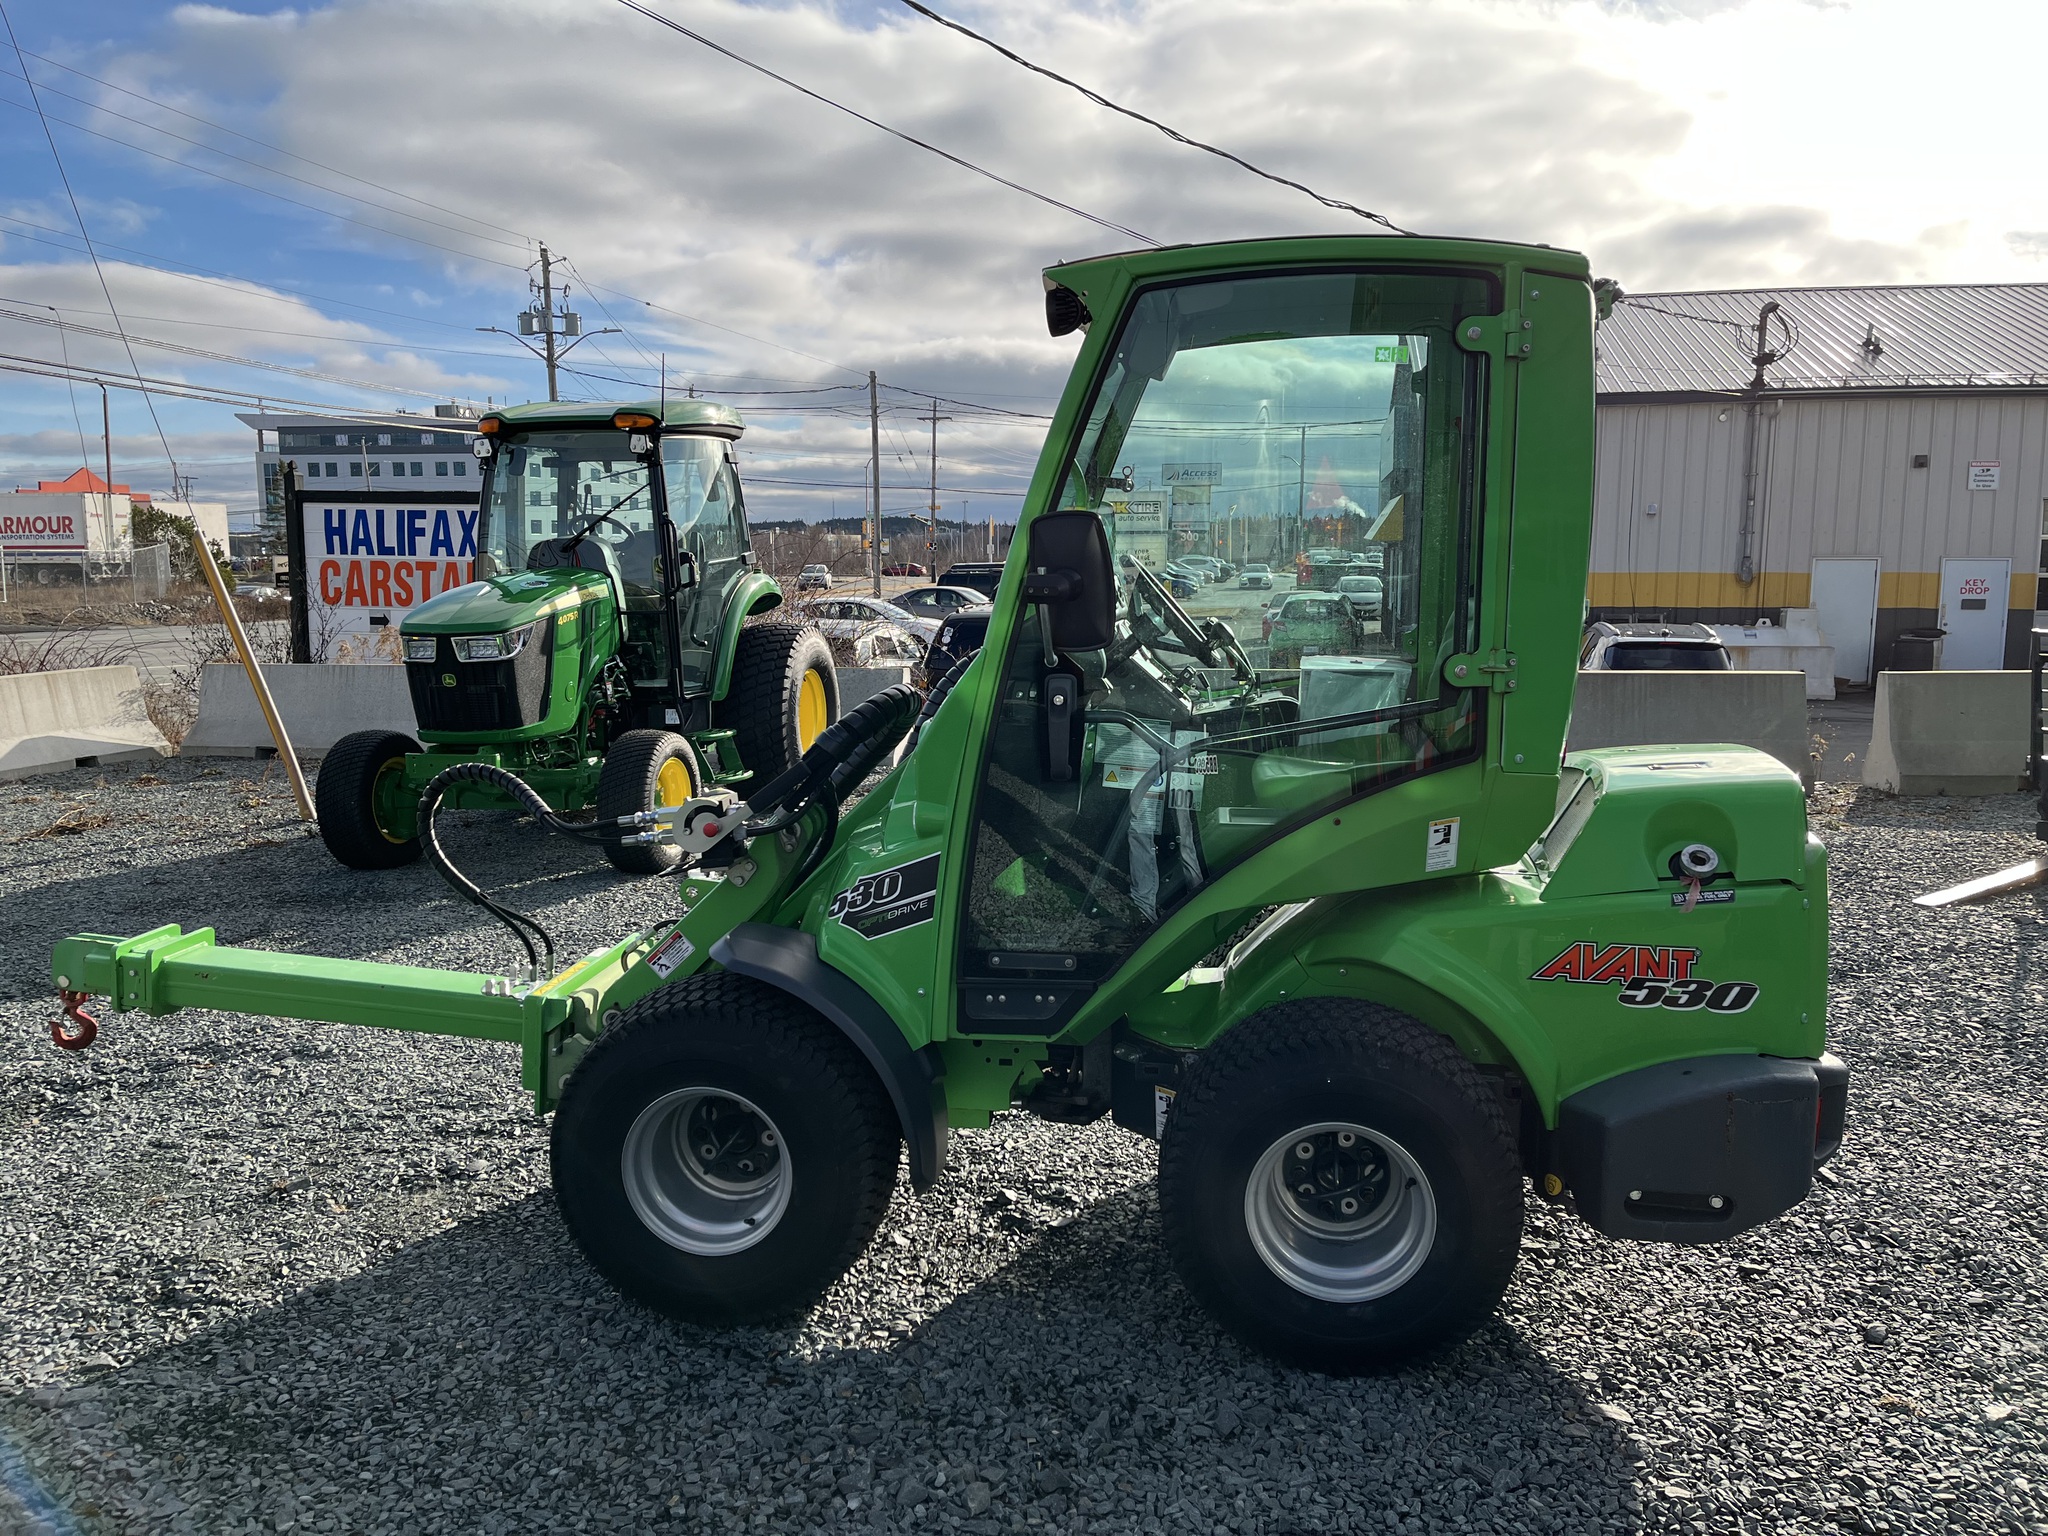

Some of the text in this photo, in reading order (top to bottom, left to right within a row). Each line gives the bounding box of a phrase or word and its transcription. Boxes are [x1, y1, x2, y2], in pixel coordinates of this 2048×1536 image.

[1181, 469, 1218, 477] Access
[1134, 502, 1160, 513] TIRE
[0, 516, 74, 534] RMOUR
[1118, 514, 1161, 522] auto service
[324, 509, 479, 557] HALIFAX
[1181, 533, 1199, 541] 300
[1960, 587, 1990, 595] DROP
[557, 611, 579, 625] 4075R
[828, 871, 902, 920] 530
[1530, 942, 1698, 984] AVANT
[1616, 975, 1760, 1014] 530
